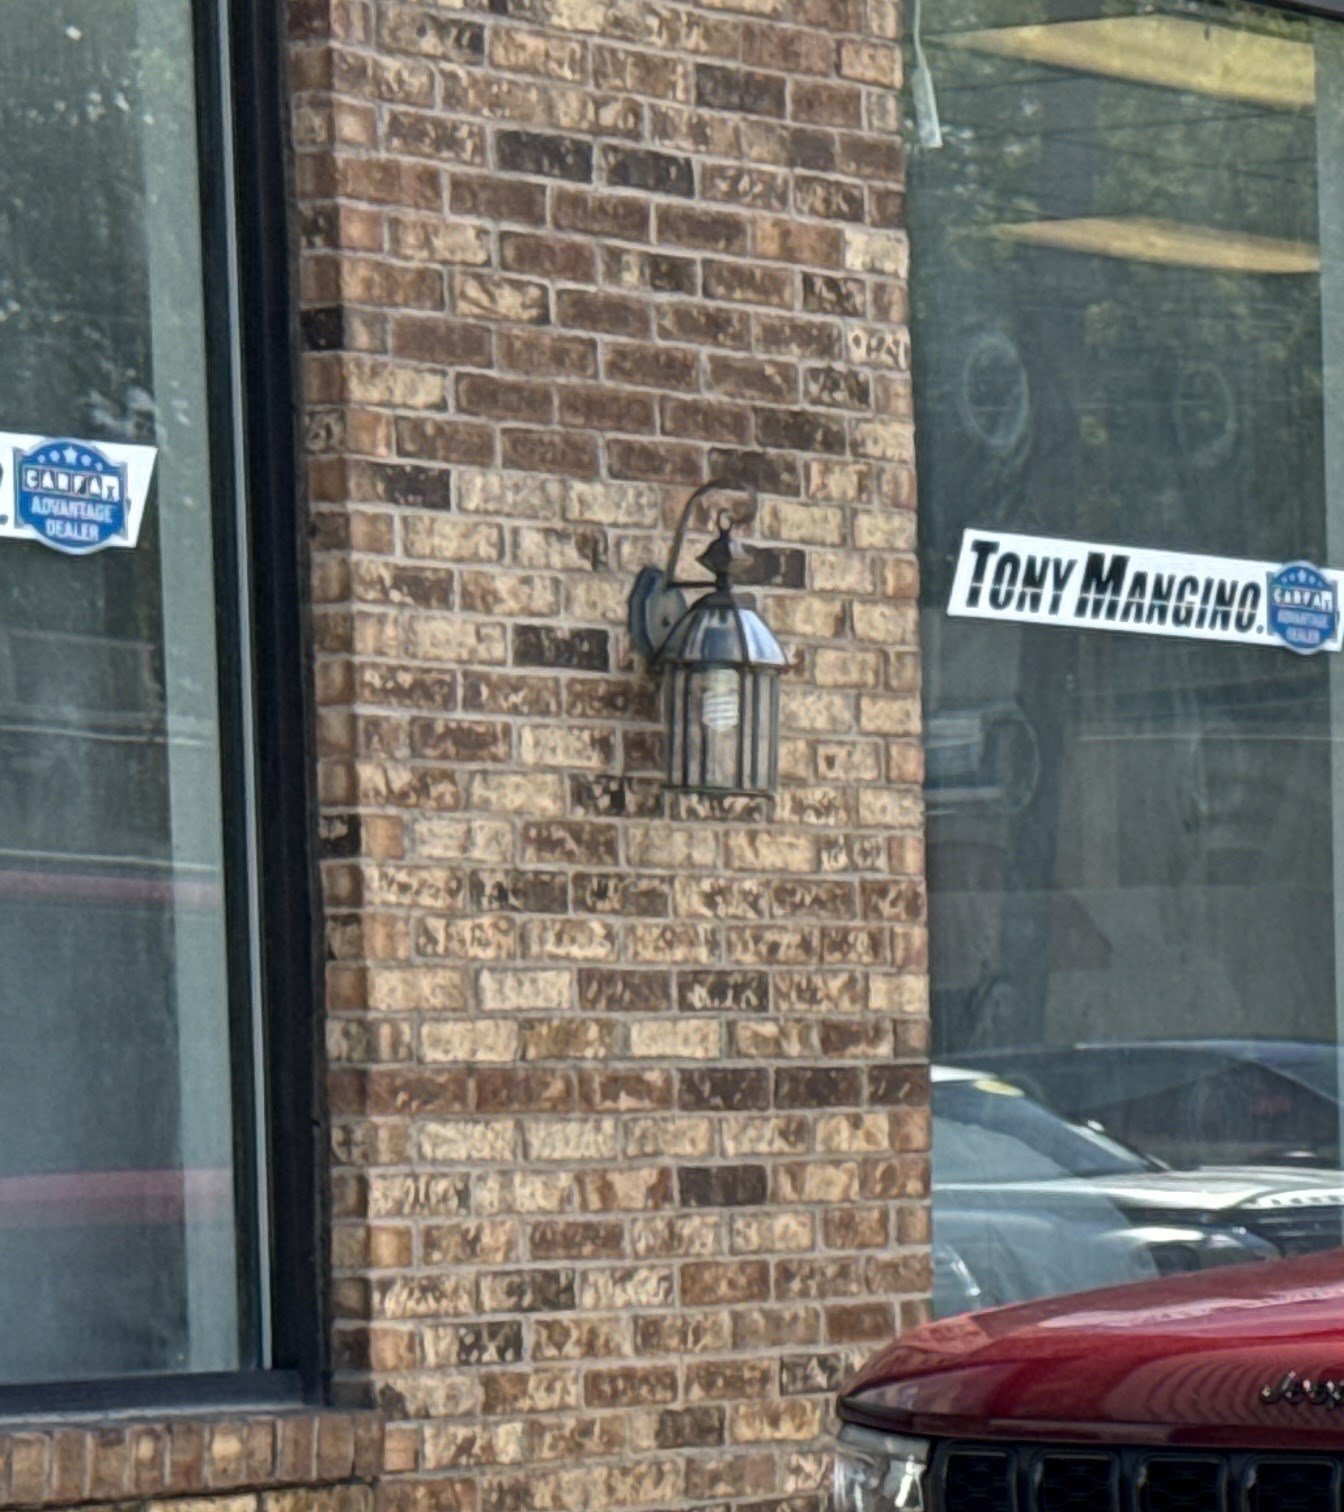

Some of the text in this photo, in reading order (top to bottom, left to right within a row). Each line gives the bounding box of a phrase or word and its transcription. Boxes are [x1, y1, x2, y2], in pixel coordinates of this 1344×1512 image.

[26, 469, 120, 502] CARFAX
[31, 496, 115, 523] ADVANTAGE
[45, 518, 99, 541] DEALER
